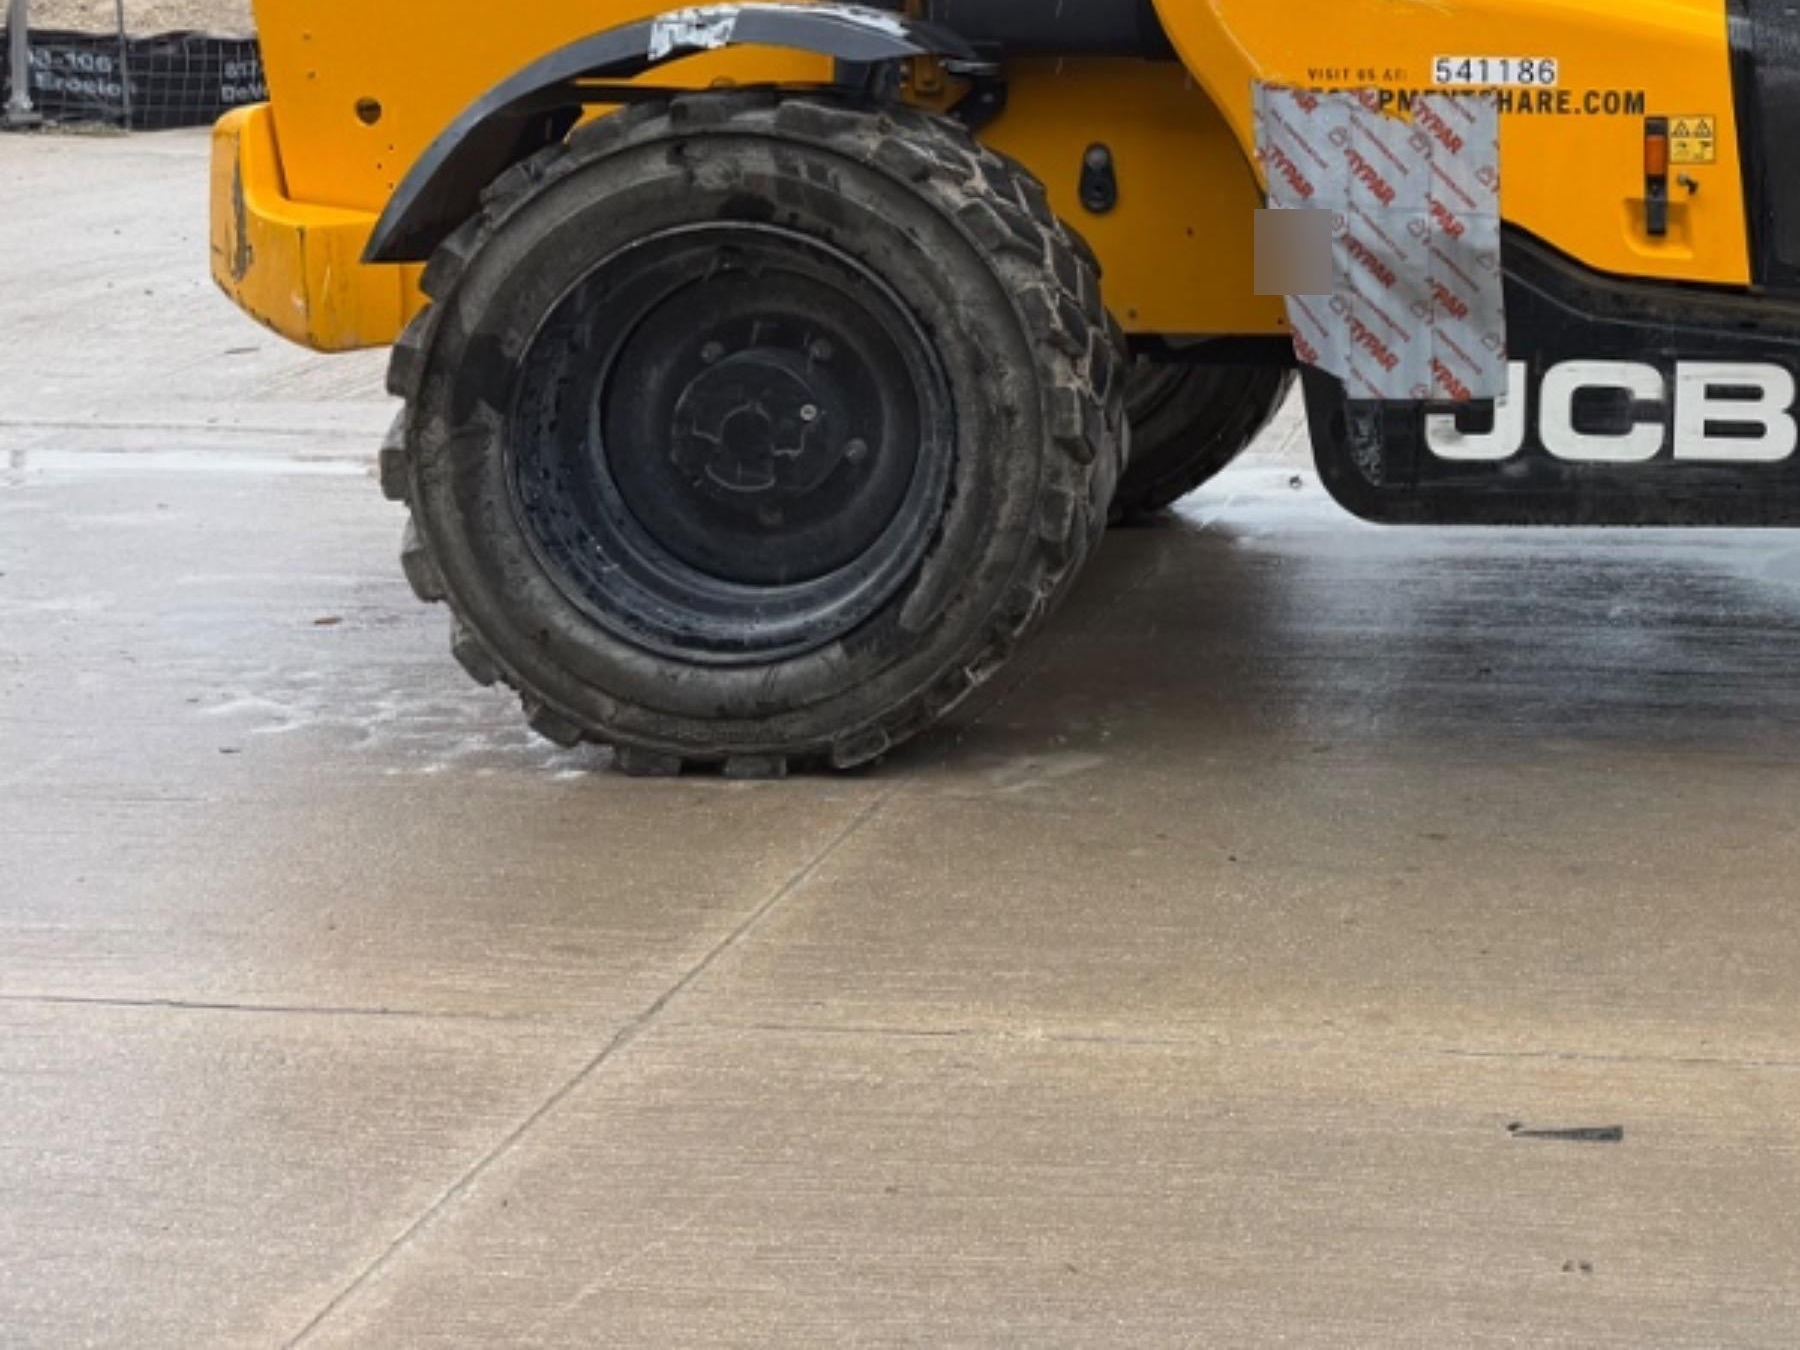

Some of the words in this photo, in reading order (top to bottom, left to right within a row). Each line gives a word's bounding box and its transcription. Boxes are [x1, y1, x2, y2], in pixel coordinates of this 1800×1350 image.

[1307, 66, 1349, 82] VISIT
[1435, 59, 1556, 84] 541186
[1344, 147, 1396, 207] TYPAR
[1345, 313, 1398, 372] TYPAR
[1422, 359, 1797, 463] JCB
